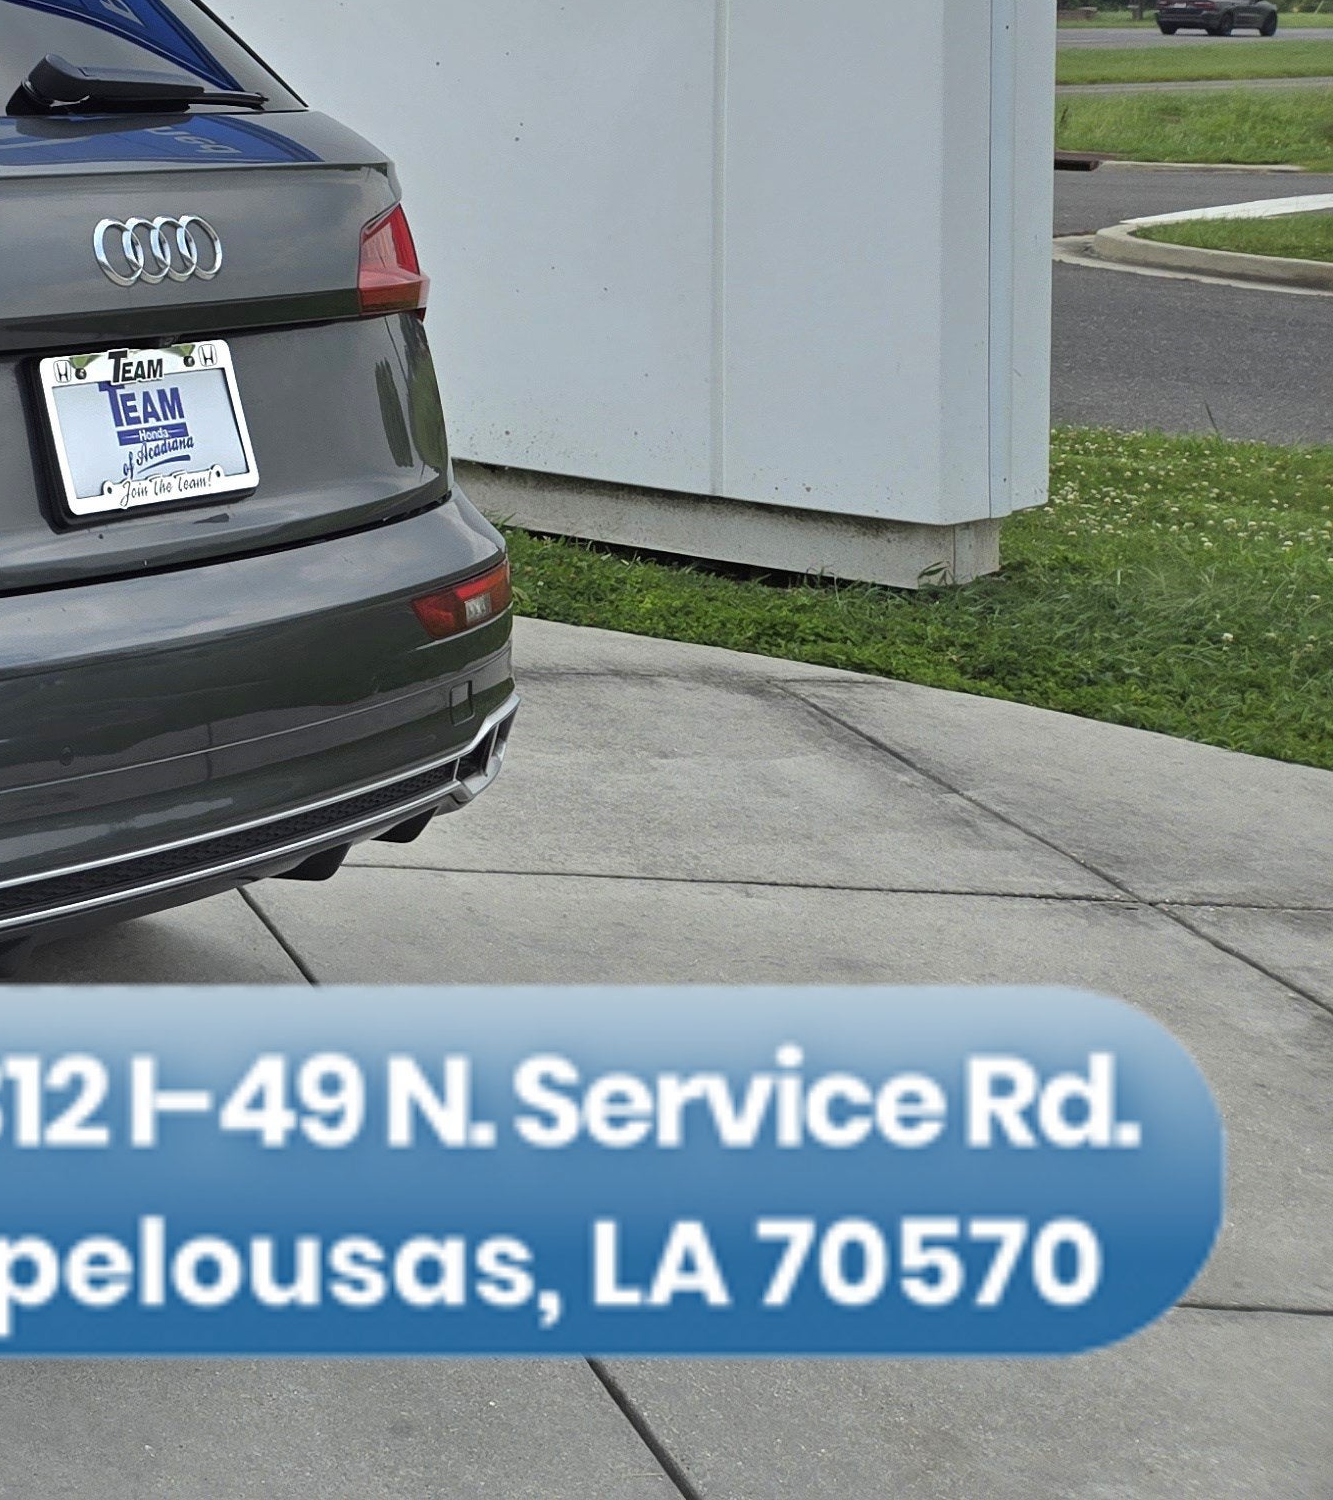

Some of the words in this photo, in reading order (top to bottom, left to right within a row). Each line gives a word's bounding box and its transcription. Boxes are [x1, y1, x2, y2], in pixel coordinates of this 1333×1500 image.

[108, 349, 164, 383] TEAM
[98, 381, 185, 427] TEAM
[138, 426, 170, 441] Honda
[122, 451, 135, 480] of
[136, 436, 195, 467] Acadiana
[119, 480, 148, 508] Join
[148, 475, 172, 496] The
